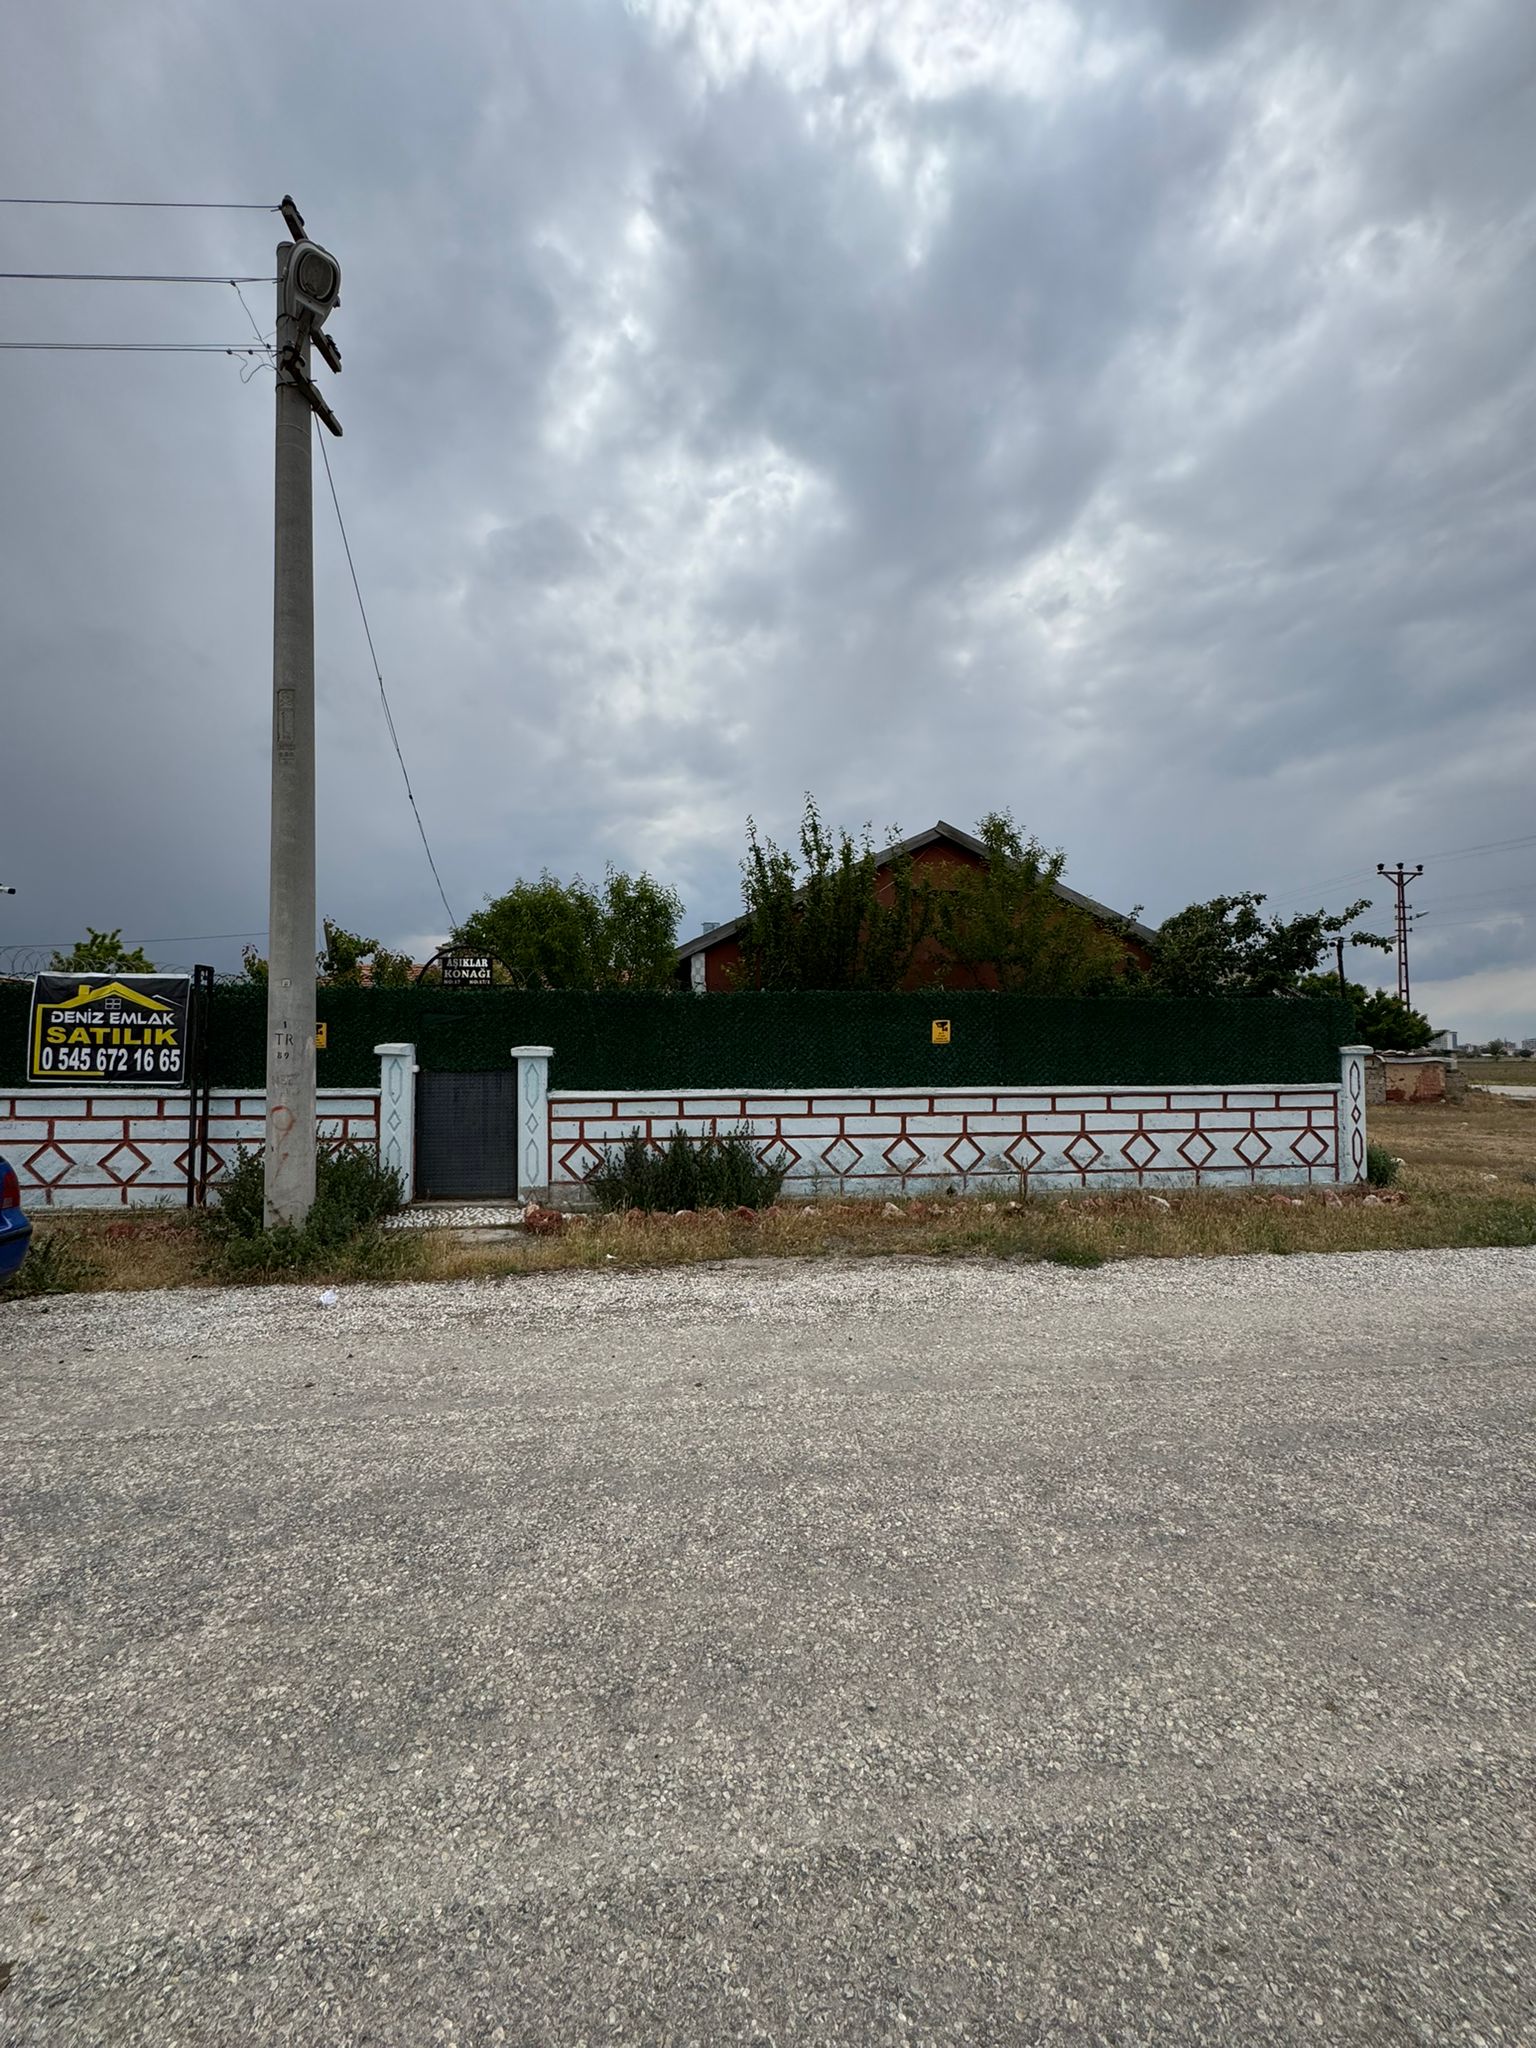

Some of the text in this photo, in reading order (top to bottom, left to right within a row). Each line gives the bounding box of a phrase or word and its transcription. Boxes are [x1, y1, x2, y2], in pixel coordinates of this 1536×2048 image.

[446, 958, 488, 969] AŞIKLAR
[444, 968, 491, 978] KONAĞI
[51, 1009, 175, 1025] DENİZ EMLAK
[46, 1026, 178, 1045] SATILIK
[275, 1033, 294, 1046] TR
[42, 1047, 181, 1072] 0 545 672 16 65
